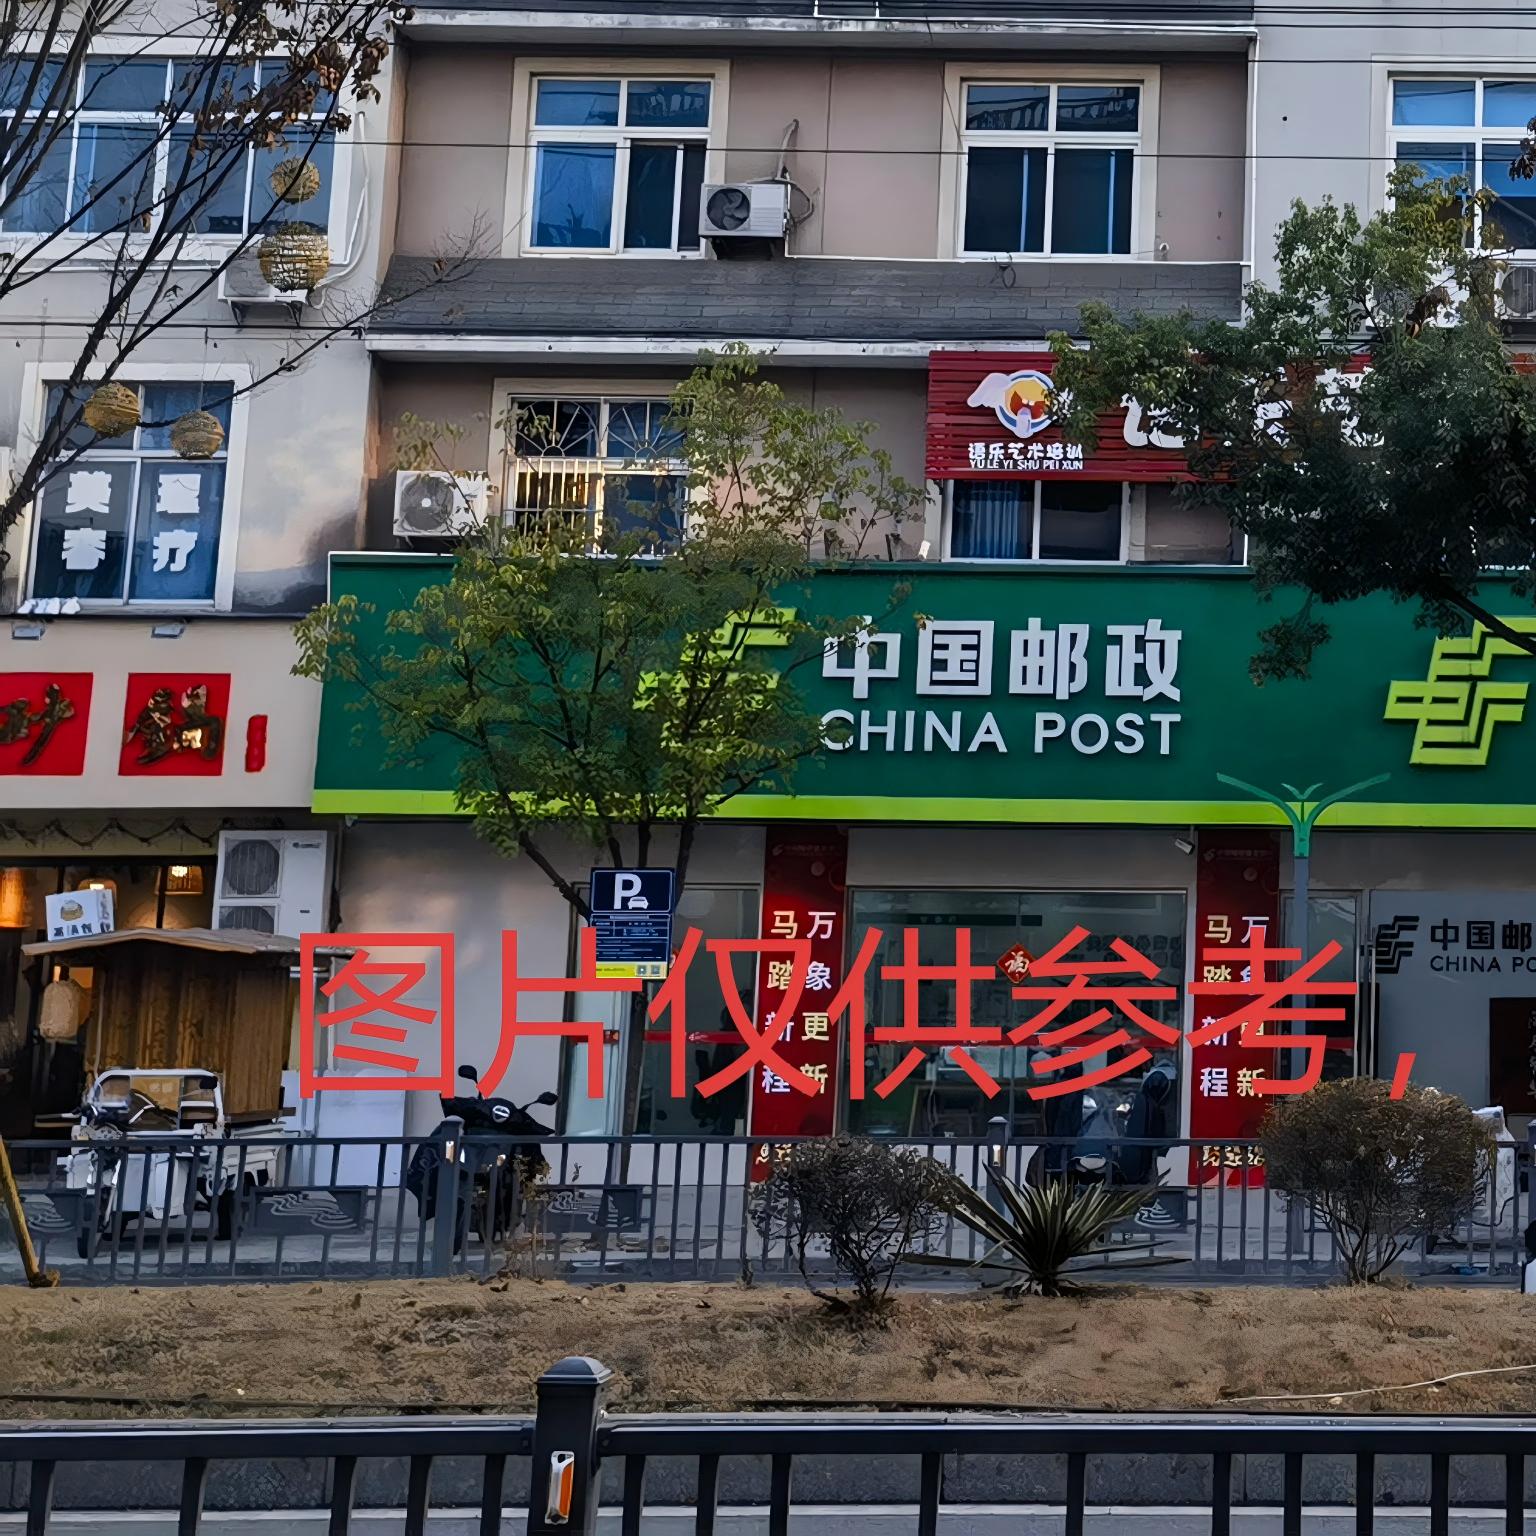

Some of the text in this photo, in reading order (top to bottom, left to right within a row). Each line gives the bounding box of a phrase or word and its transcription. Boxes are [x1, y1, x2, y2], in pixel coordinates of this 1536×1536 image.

[822, 615, 1182, 702] 中国邮政
[820, 709, 1181, 755] CHINA POST
[613, 873, 642, 910] P
[1430, 955, 1501, 973] CHINA
